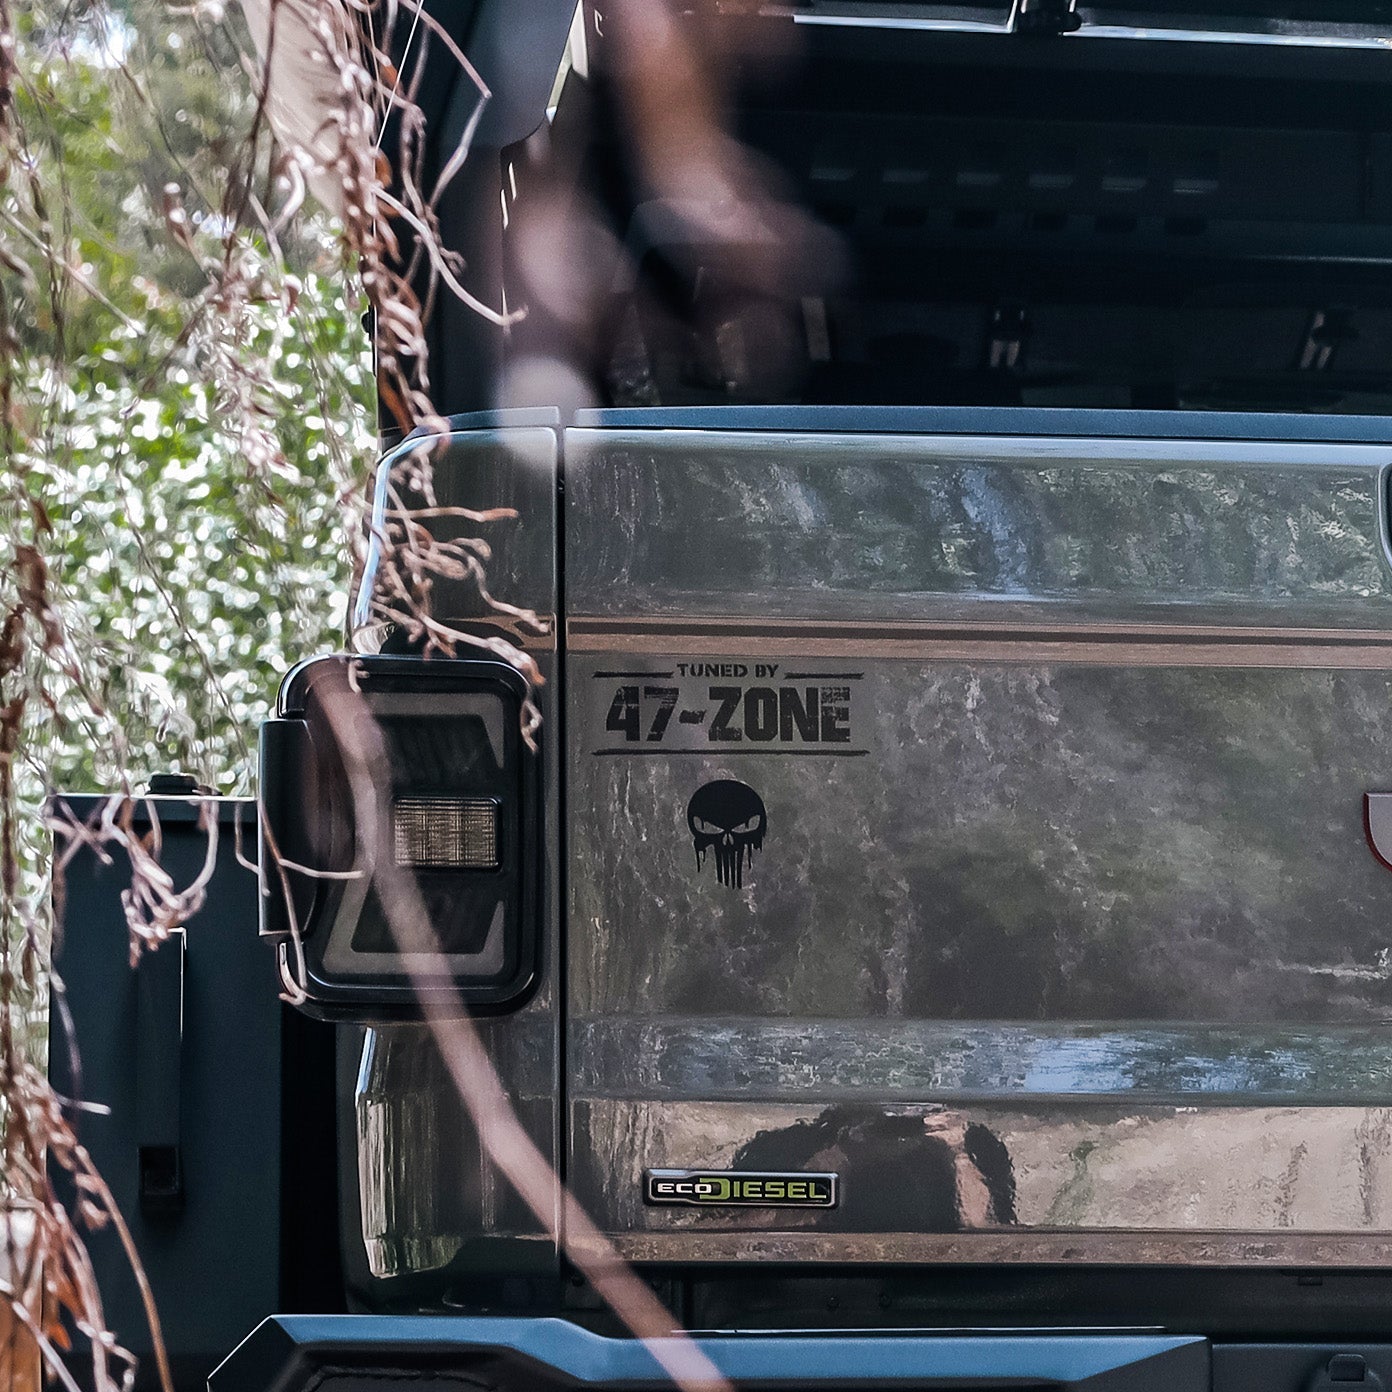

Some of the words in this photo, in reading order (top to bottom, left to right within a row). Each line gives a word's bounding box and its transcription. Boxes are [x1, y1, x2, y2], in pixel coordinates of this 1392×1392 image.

[676, 663, 748, 678] TUNED
[754, 663, 780, 679] BY
[605, 685, 851, 743] 47-ZONE
